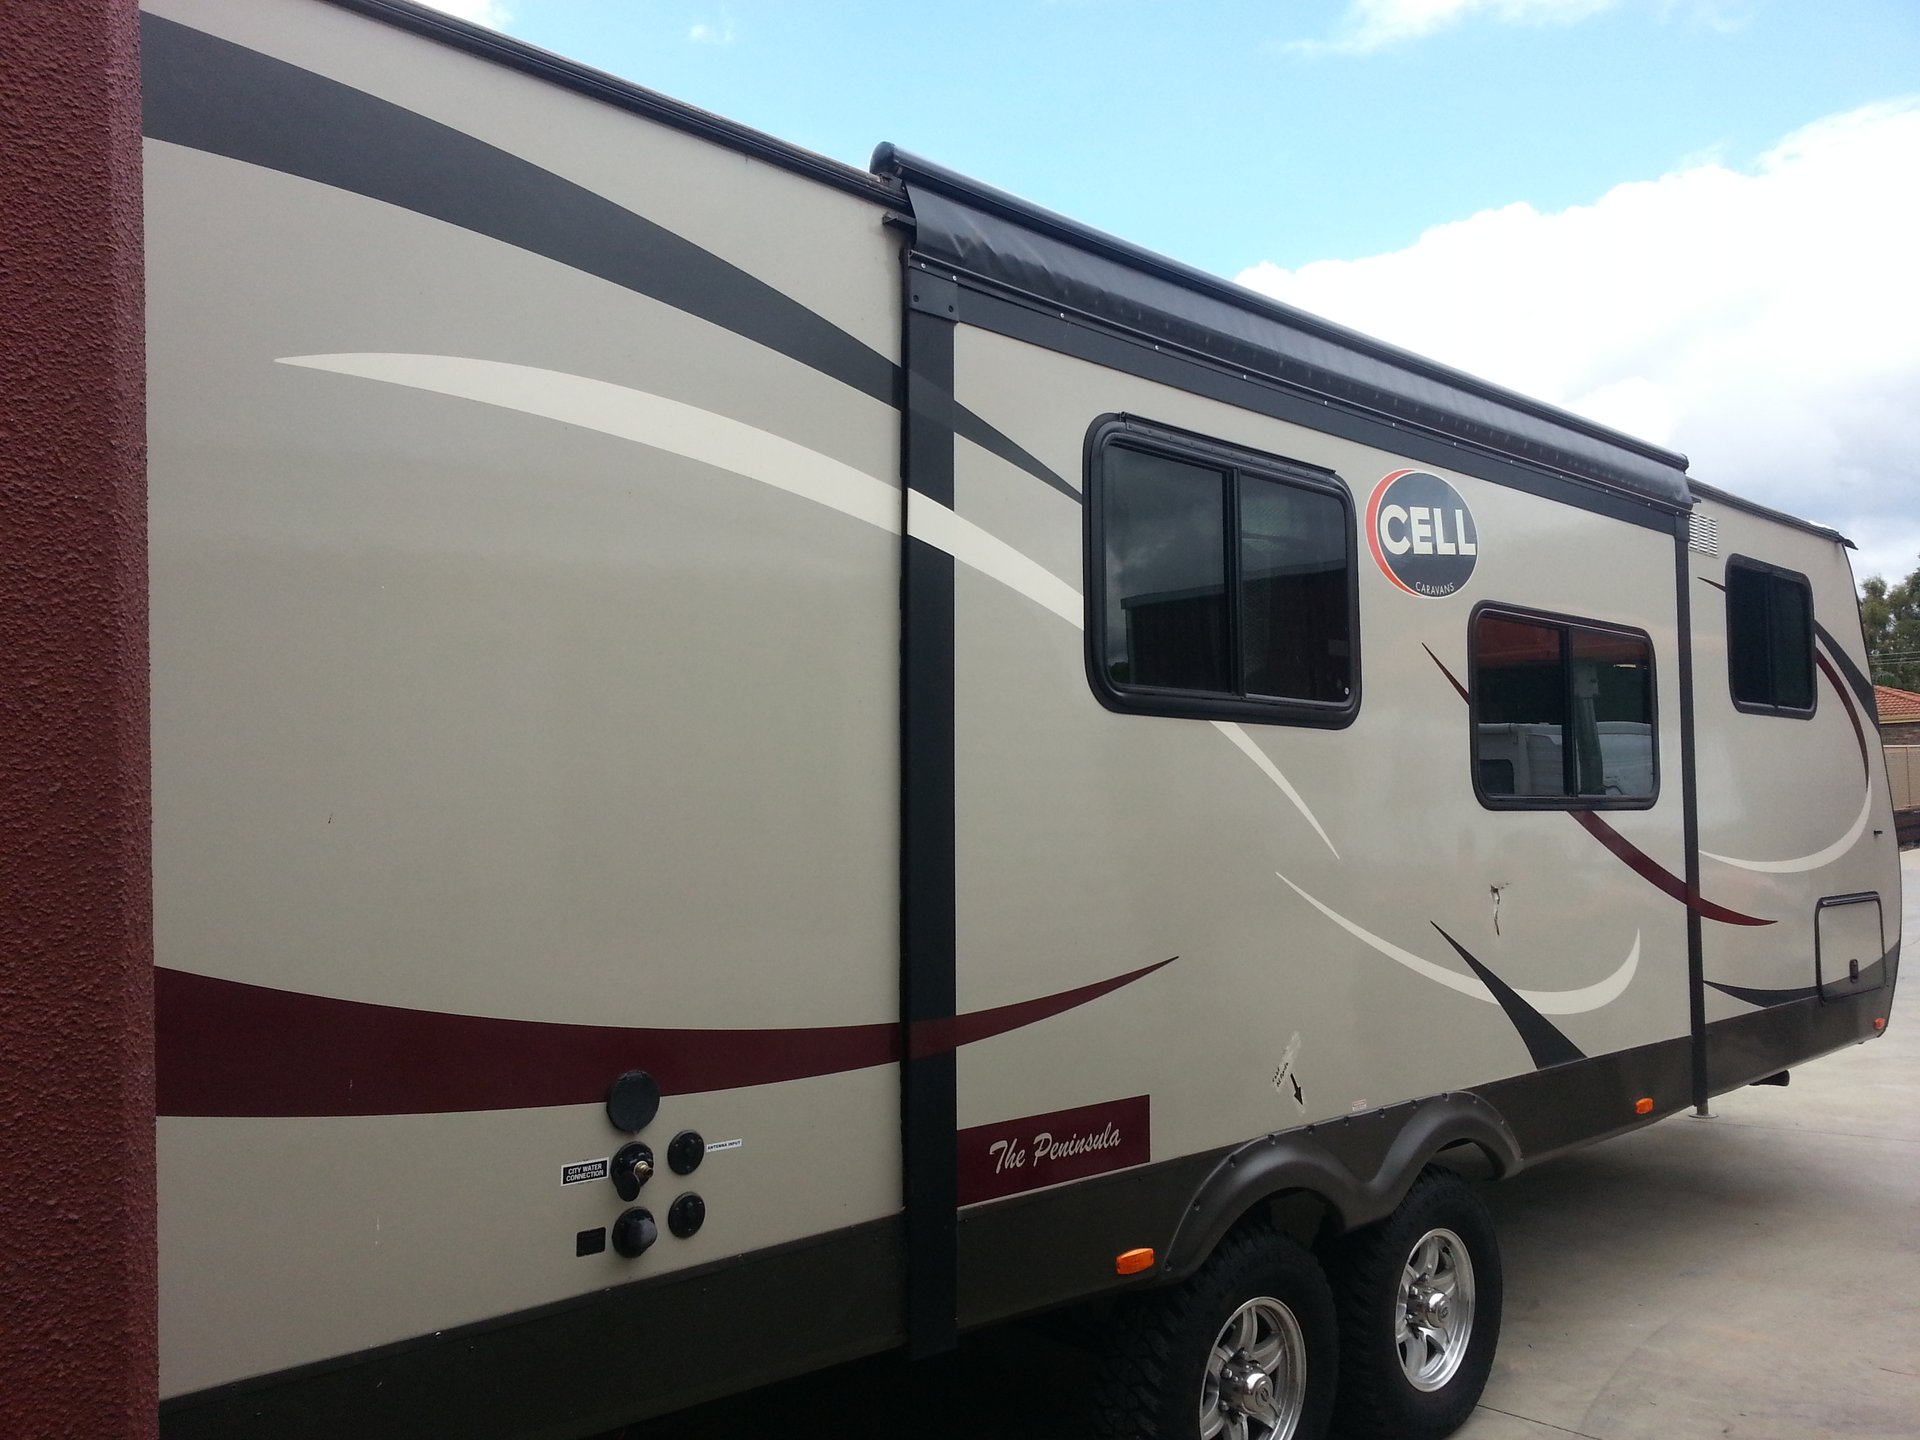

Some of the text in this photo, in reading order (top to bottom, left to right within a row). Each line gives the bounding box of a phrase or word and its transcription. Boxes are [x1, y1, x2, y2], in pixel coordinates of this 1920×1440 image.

[1380, 504, 1476, 555] CELL
[1415, 581, 1454, 595] CARAVANS
[989, 1121, 1121, 1174] The Peninsula
[566, 1170, 603, 1182] CONNECTION
[568, 1163, 602, 1175] CITY WATER
